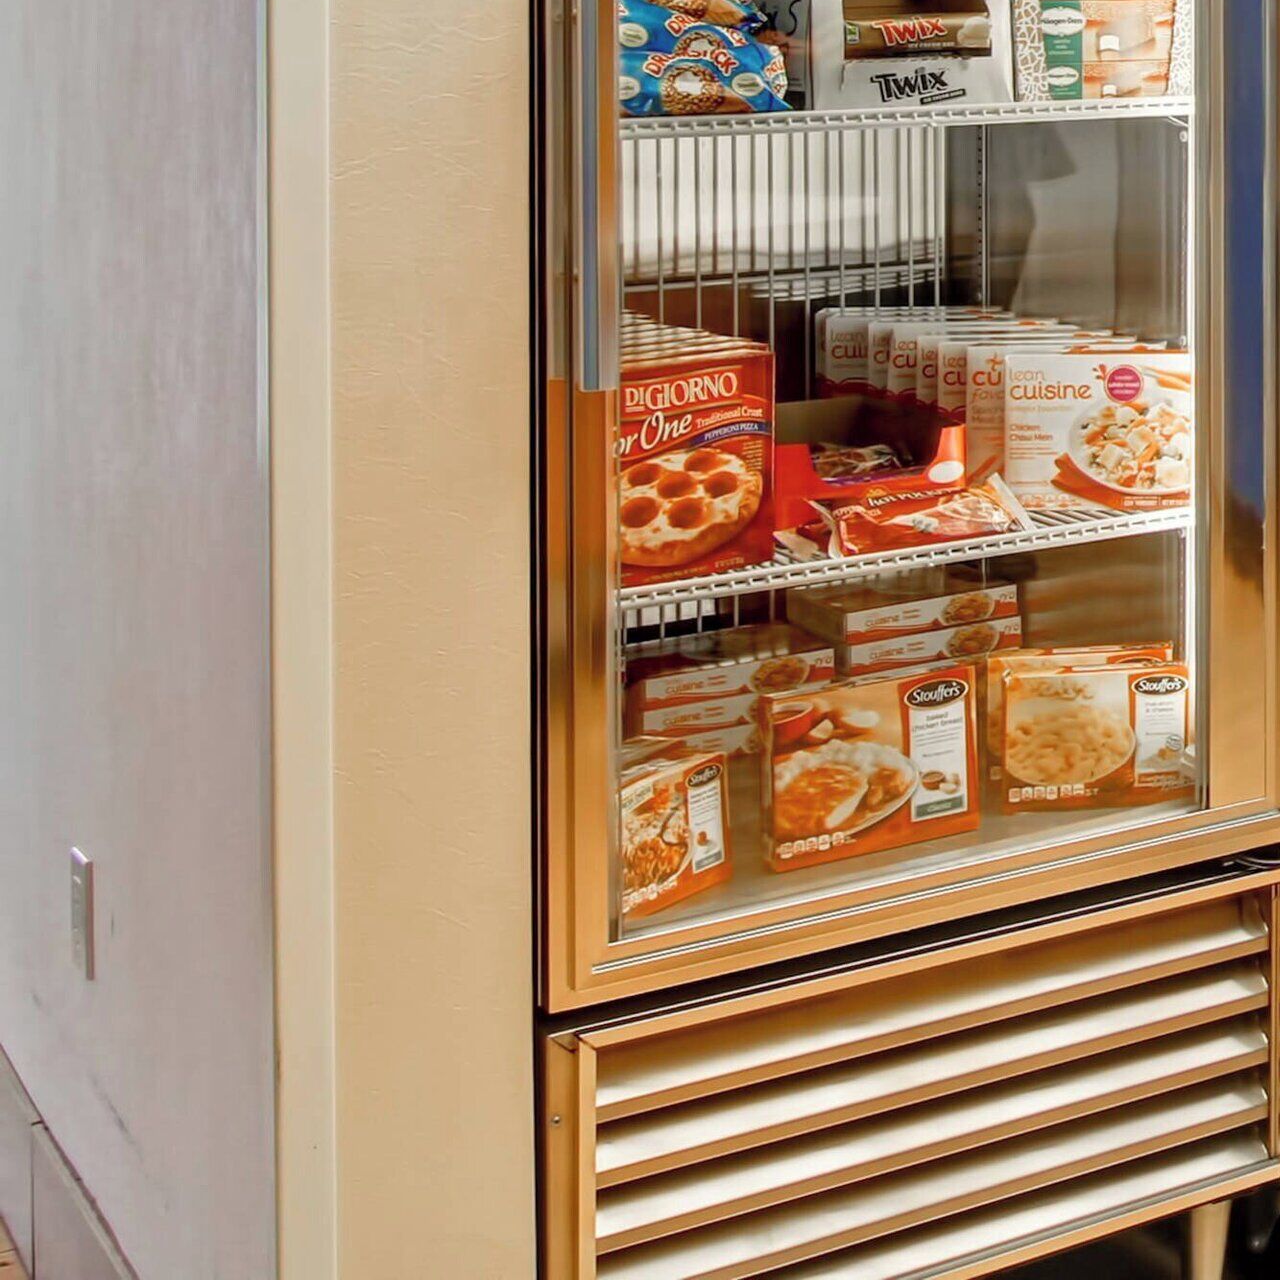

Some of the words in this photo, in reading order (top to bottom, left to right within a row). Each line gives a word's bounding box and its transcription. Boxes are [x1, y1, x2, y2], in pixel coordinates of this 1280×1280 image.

[1008, 367, 1046, 383] lean
[1009, 381, 1093, 401] cuisine
[696, 407, 742, 429] Traditional
[741, 405, 764, 419] Crust
[639, 411, 693, 451] One
[704, 424, 740, 441] PEPPERONI
[739, 422, 760, 434] PIZZA
[912, 681, 961, 704] Stouffer's
[1137, 676, 1183, 694] Stouffer's
